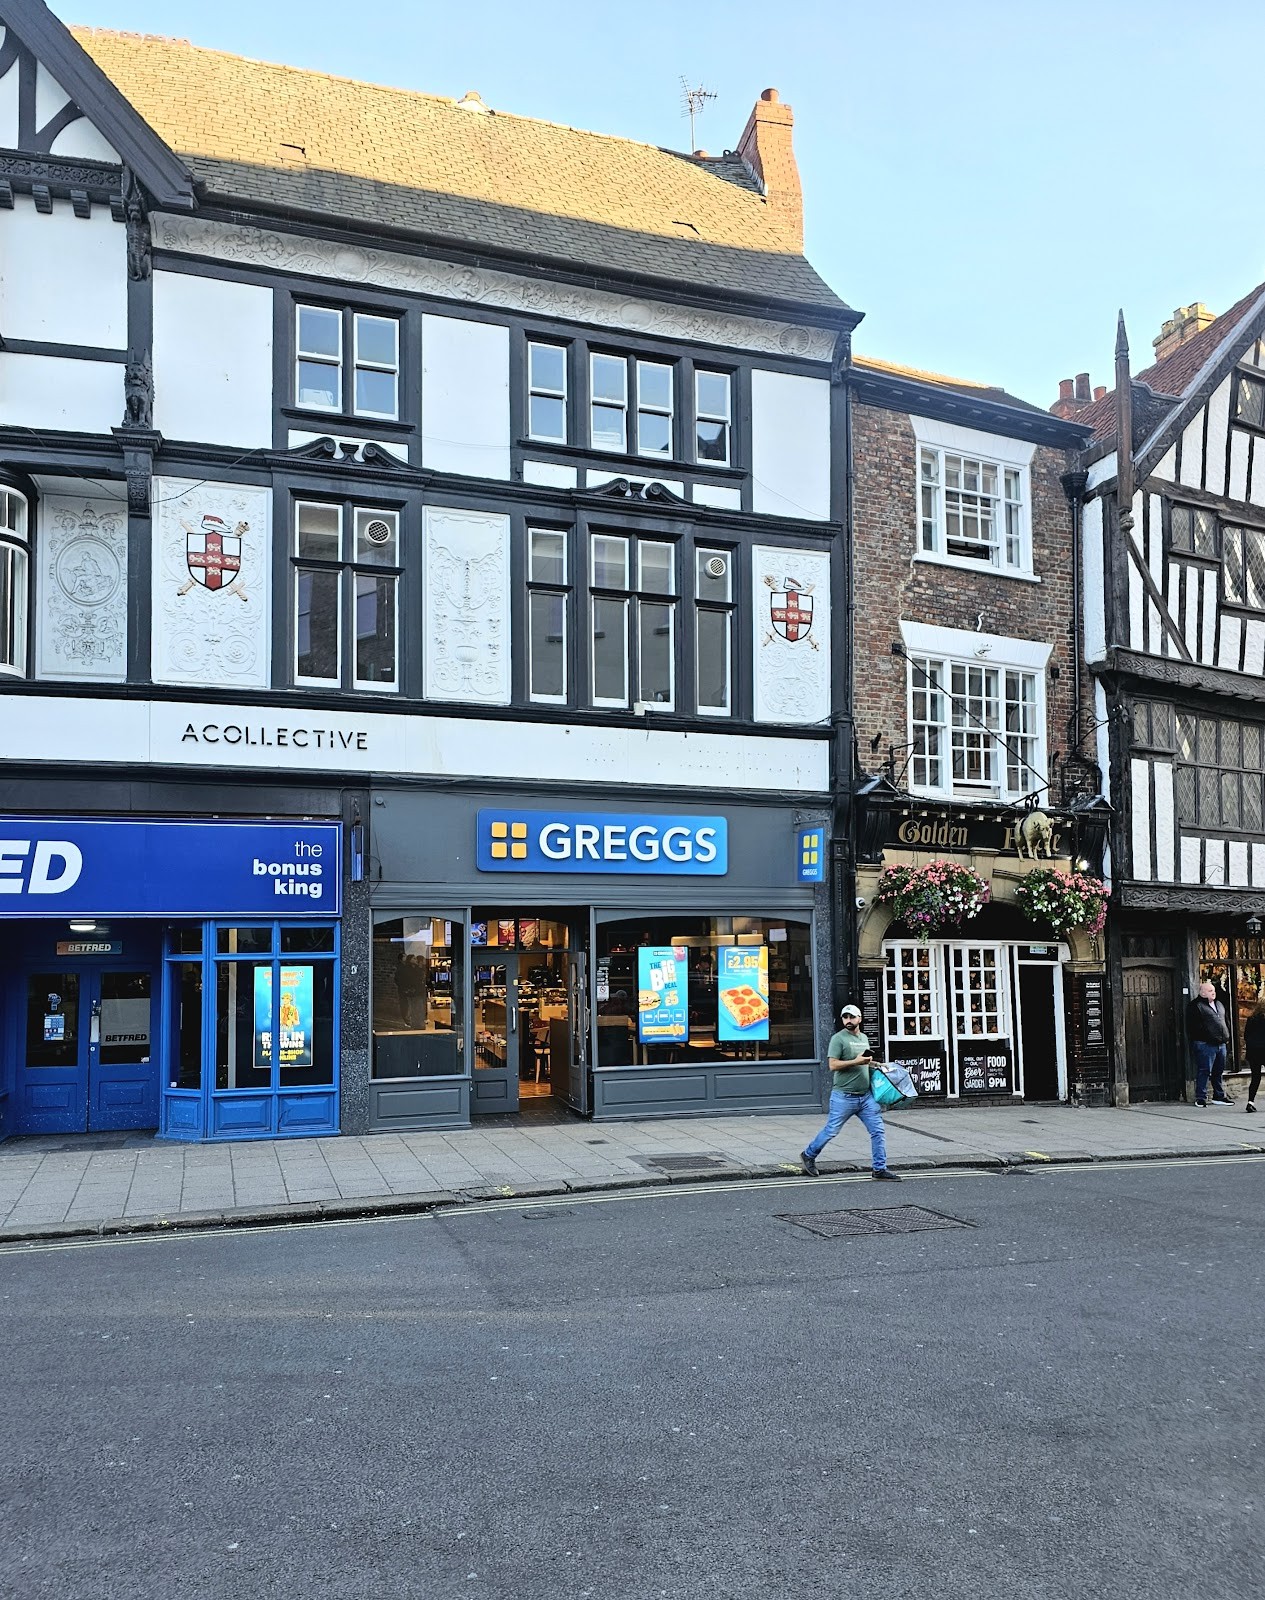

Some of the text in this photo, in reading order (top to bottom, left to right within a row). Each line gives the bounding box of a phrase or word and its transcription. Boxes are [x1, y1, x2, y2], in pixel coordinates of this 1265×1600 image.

[181, 723, 368, 750] ACOLLECTIVE
[898, 820, 969, 847] Golden
[294, 840, 323, 857] the
[539, 822, 717, 862] GREGGS
[0, 840, 83, 894] ED
[252, 858, 323, 876] bonus
[802, 868, 818, 876] GREGGS
[273, 878, 323, 899] king
[67, 943, 112, 952] BETFRED
[649, 961, 661, 970] THE
[727, 955, 759, 969] £2.95
[649, 959, 676, 992] BIG
[664, 981, 678, 990] DEAL
[105, 1034, 148, 1042] BETFRED
[290, 1031, 305, 1041] IN
[923, 1058, 941, 1070] LIVE
[987, 1055, 1007, 1068] FOOD
[963, 1066, 985, 1079] Beer
[924, 1080, 942, 1092] 9PM
[963, 1078, 985, 1089] GARDEN
[988, 1076, 1007, 1088] 9PM
